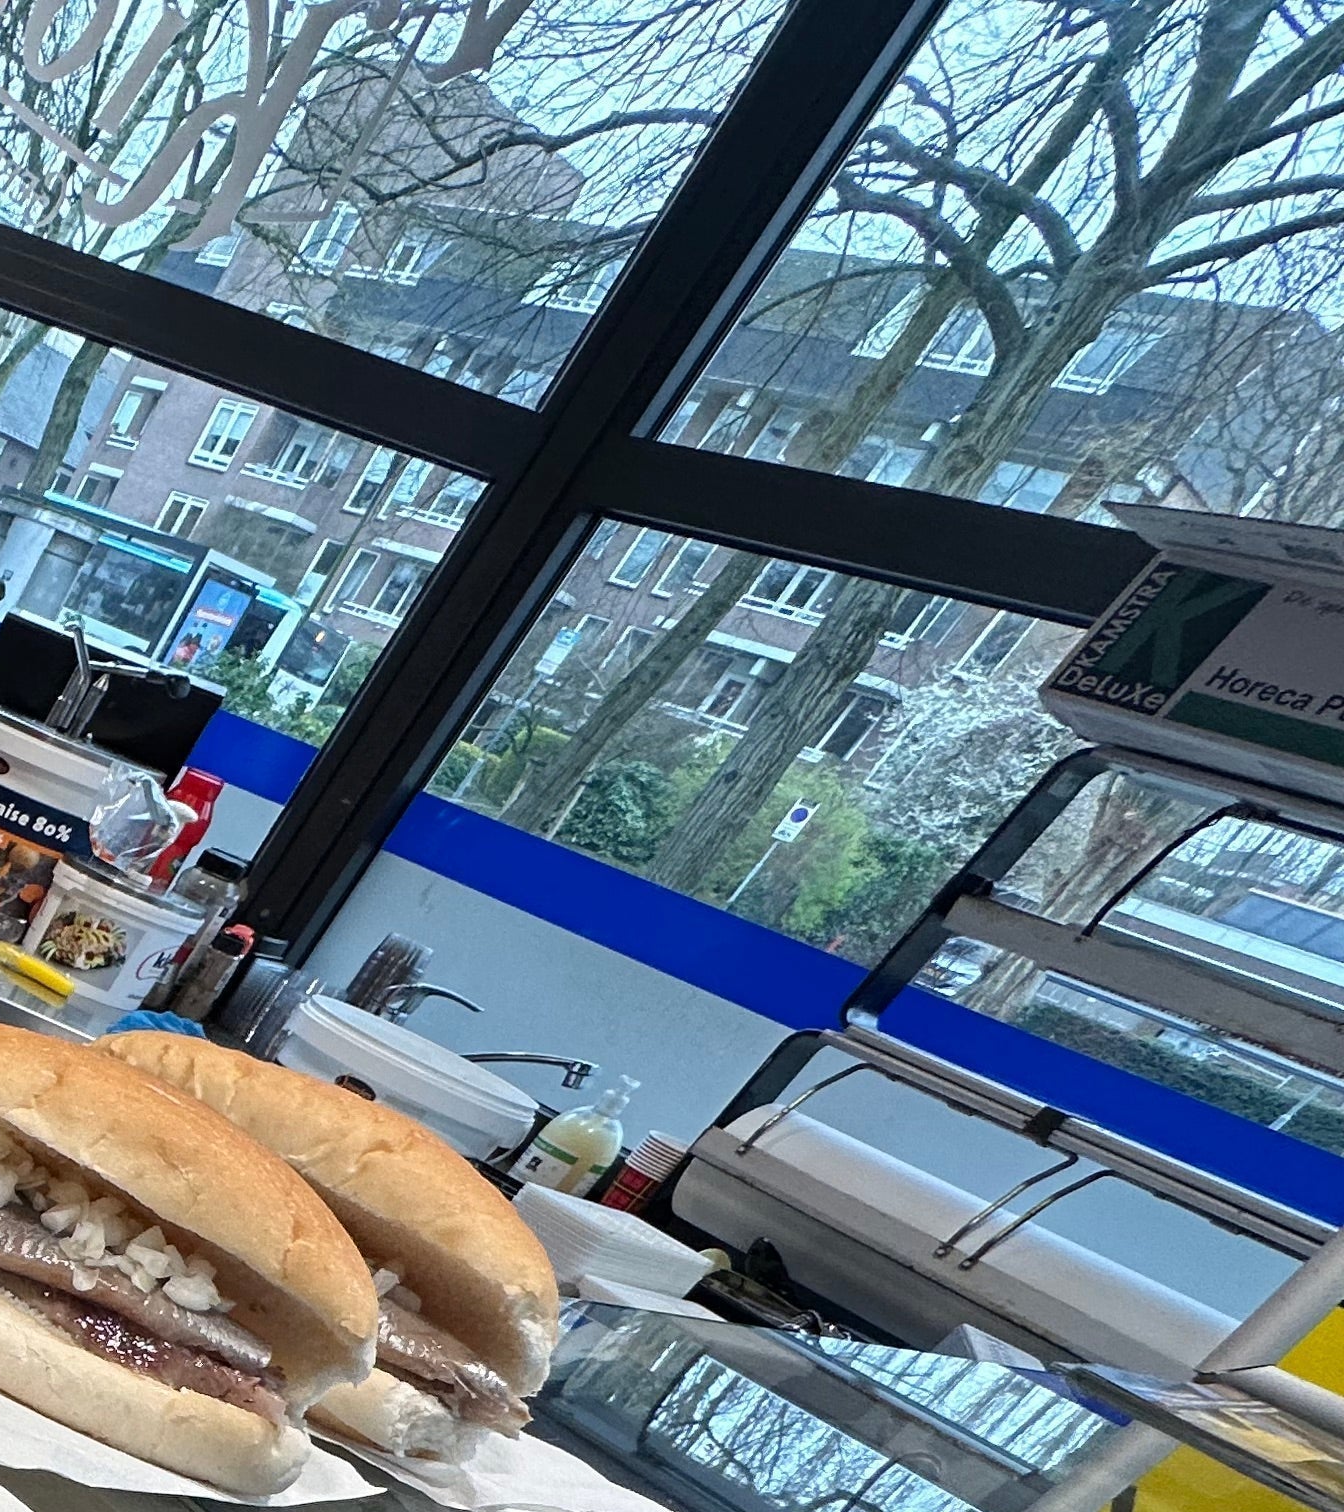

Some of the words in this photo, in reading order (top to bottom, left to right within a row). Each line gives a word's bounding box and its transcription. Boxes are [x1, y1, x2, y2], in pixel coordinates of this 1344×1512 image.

[1075, 569, 1176, 669] KAMSTRA
[1205, 665, 1313, 713] Horeca
[32, 815, 74, 843] 80%
